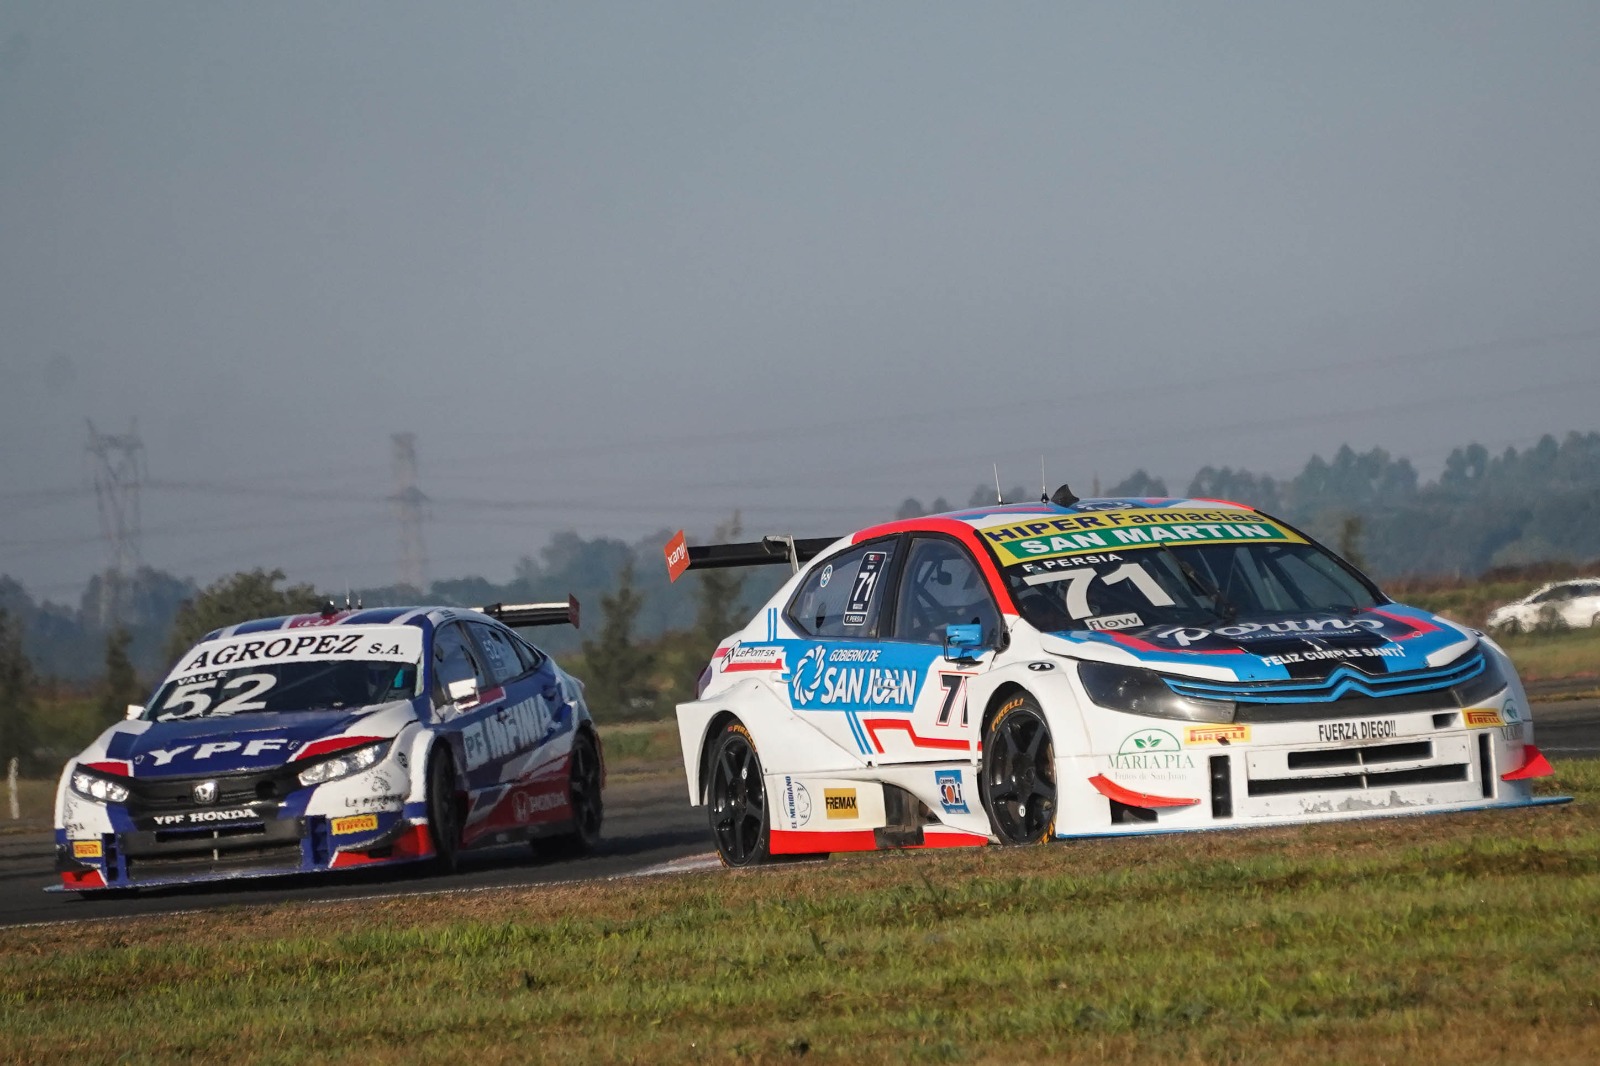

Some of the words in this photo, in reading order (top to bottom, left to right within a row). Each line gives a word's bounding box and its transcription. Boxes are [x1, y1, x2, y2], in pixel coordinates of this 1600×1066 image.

[984, 514, 1107, 542] HIPER
[1105, 508, 1265, 526] Farmacias
[1020, 531, 1105, 555] SAN
[1111, 522, 1271, 544] MARTIN
[1022, 561, 1042, 573] F.
[1046, 552, 1123, 570] PERSIA
[855, 572, 877, 602] 71
[1023, 562, 1176, 620] 71
[1089, 616, 1138, 630] flow
[184, 634, 364, 672] AGROPEZ
[367, 642, 404, 655] S.A.
[829, 649, 868, 662] GOBIERNO
[867, 649, 882, 662] DE
[1261, 652, 1304, 667] FELIZ
[1302, 647, 1362, 662] CUMPLE
[178, 670, 228, 685] VALLE
[820, 666, 865, 704] SAN
[863, 668, 917, 706] JUAN
[156, 673, 277, 723] 52
[992, 698, 1024, 732] PIRELLI
[1466, 711, 1502, 725] PIRELLI
[1190, 726, 1246, 742] PIRELLI
[1318, 722, 1359, 741] FUERZA
[1361, 719, 1397, 739] DIEGO!!
[149, 738, 288, 766] YPF
[1107, 754, 1161, 770] MARIA
[1163, 753, 1195, 769] PIA
[1151, 771, 1166, 780] San
[1167, 771, 1187, 781] Juan
[785, 776, 796, 818] MERIDIANO
[825, 796, 857, 810] FREMAX
[153, 814, 185, 825] YPF
[188, 808, 260, 823] HONDA
